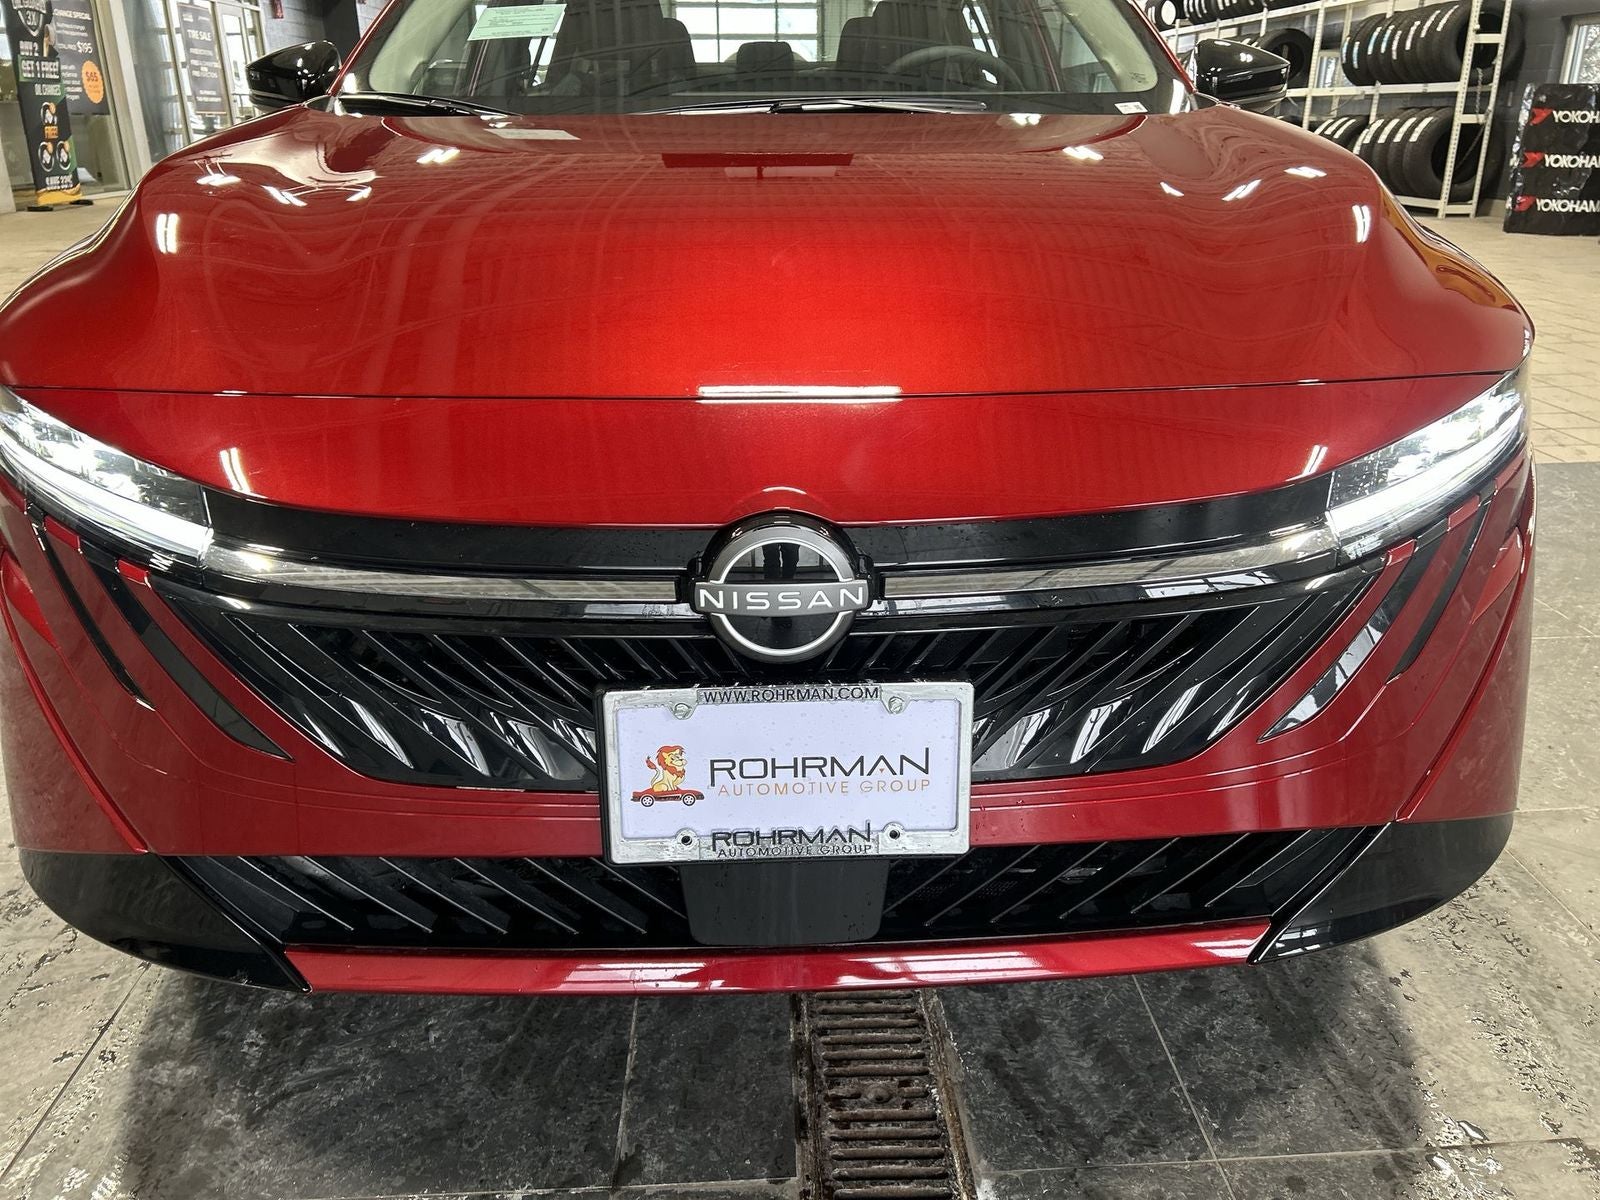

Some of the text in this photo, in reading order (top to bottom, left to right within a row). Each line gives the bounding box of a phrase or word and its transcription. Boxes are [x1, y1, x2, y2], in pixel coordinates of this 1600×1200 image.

[1552, 110, 1600, 124] YOKOH
[1544, 154, 1600, 168] YOKOHA
[699, 586, 863, 610] NISSAN
[703, 686, 879, 703] WWW.ROHRMAN.COM
[709, 747, 930, 787] ROHRMAN
[718, 779, 931, 796] AUTOMOTIVE GROUP
[711, 821, 871, 855] ROHRMAN
[717, 843, 872, 858] AUTOMOTIVE GROUP
